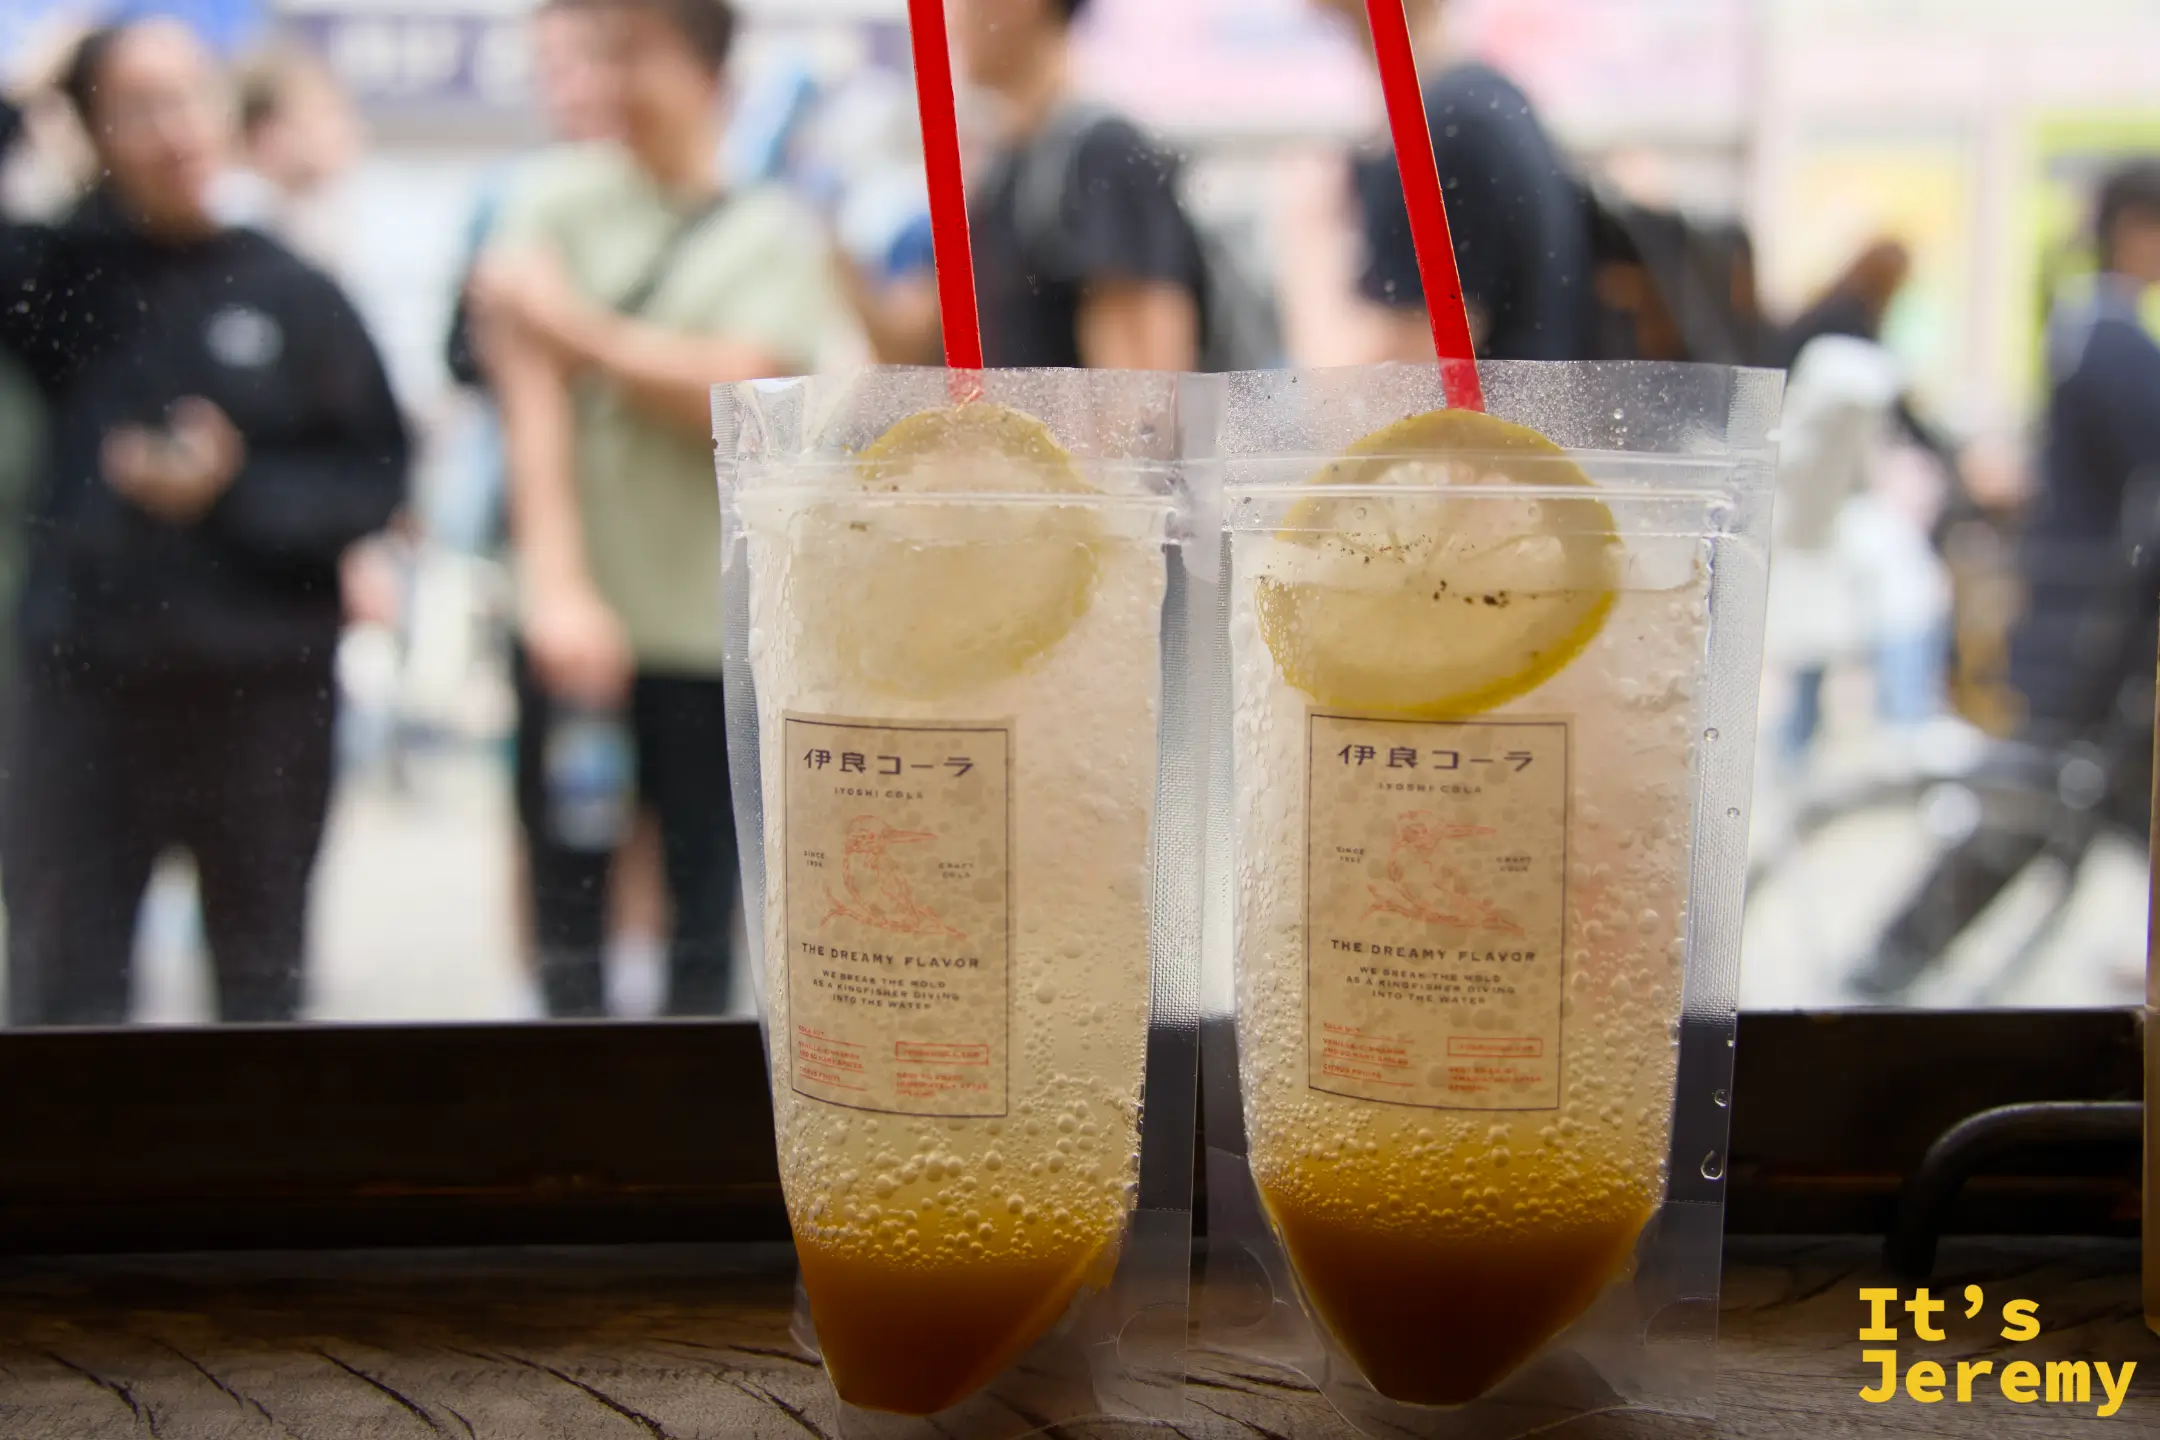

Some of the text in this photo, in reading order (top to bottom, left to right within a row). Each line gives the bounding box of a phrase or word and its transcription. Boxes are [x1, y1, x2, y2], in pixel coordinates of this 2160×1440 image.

[803, 749, 974, 777] 伊良コーラ
[1337, 744, 1534, 773] 伊良コーラ
[834, 787, 924, 800] IYOSHI COLA
[1379, 782, 1482, 794] IYOSHI COLA
[801, 942, 980, 969] THE DREAMY FLAVOR
[1331, 939, 1536, 962] THE DREAMY FLAVOR
[822, 969, 837, 979] WE
[839, 973, 876, 985] BREAK
[881, 977, 904, 987] THE
[1359, 966, 1377, 975] WE
[1382, 968, 1427, 979] BREAK
[1432, 972, 1458, 982] THE
[813, 979, 961, 1001] AS A KINGFISHER DIVING
[1346, 975, 1516, 995] AS A KINGFISHER DIVING
[832, 994, 931, 1010] INTO THE WATER
[1371, 990, 1486, 1005] INTO THE WATER
